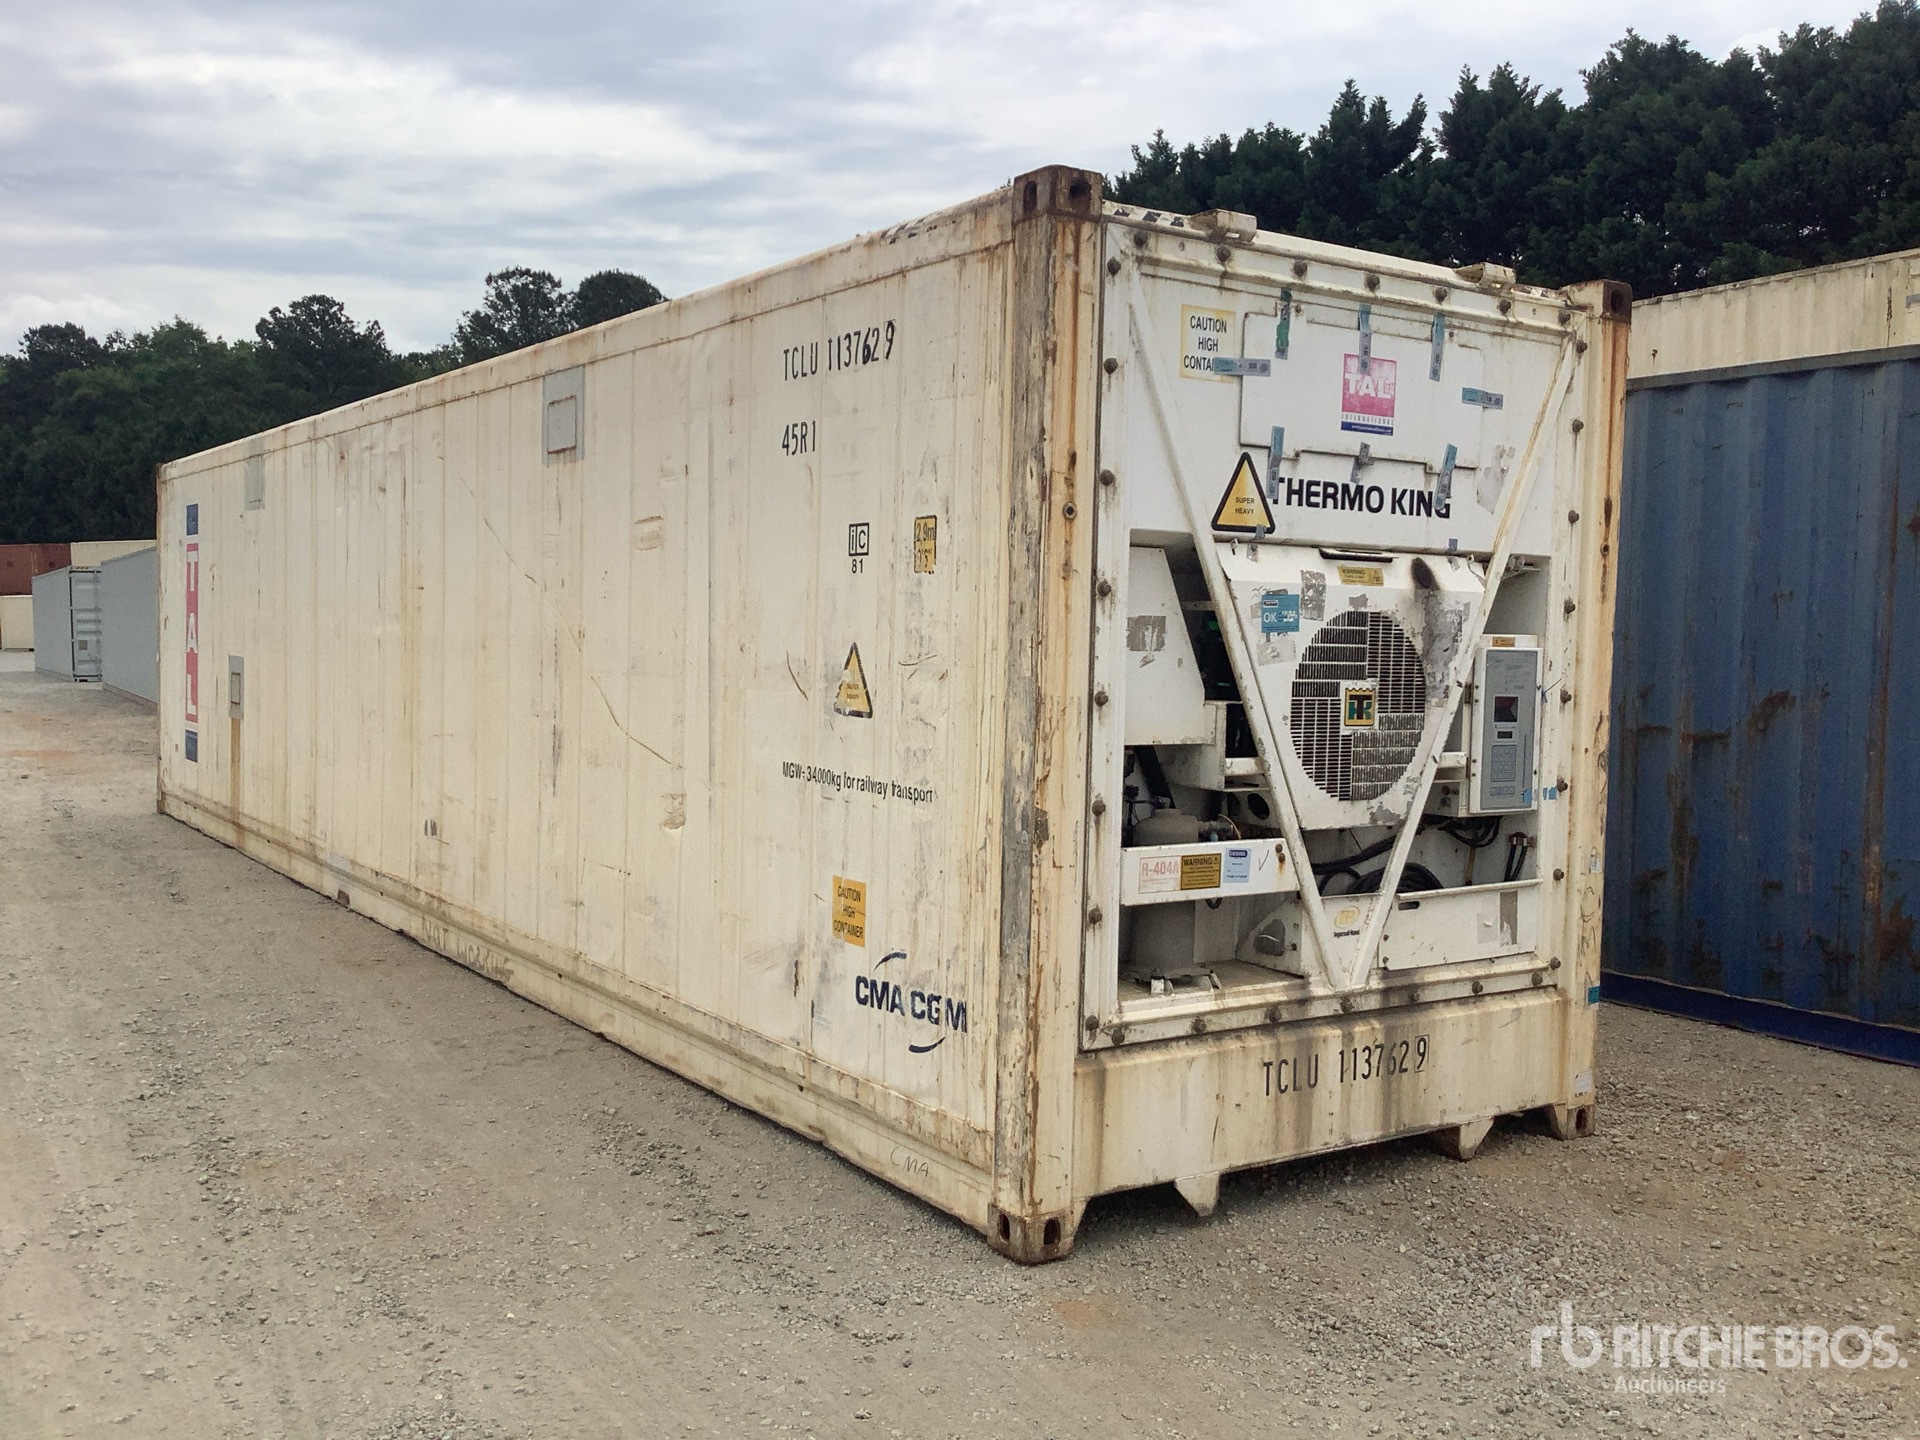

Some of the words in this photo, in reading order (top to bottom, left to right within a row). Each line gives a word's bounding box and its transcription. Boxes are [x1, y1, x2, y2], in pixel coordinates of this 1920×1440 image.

[1190, 315, 1227, 333] CAUTION
[1198, 336, 1219, 352] HIGH
[783, 341, 818, 381] TCLU
[1183, 355, 1214, 371] CONTAI
[1344, 372, 1392, 399] TAL
[782, 420, 816, 456] 45R1
[1235, 496, 1255, 504] SUPER
[1235, 507, 1254, 515] HEAVY
[851, 558, 864, 574] 81
[1263, 611, 1277, 623] OK
[187, 550, 199, 716] TAL
[843, 771, 856, 789] for
[856, 775, 888, 800] railway
[891, 780, 933, 805] transport
[1141, 860, 1179, 876] R-404A
[1183, 857, 1213, 866] WARNING
[837, 885, 861, 902] CAUTION
[842, 904, 856, 918] HIGH
[833, 919, 864, 939] CONTAINER
[855, 975, 905, 1017] CMA
[910, 989, 968, 1034] CGM
[1263, 1053, 1319, 1097] TCLU
[890, 1146, 929, 1177] CMA
